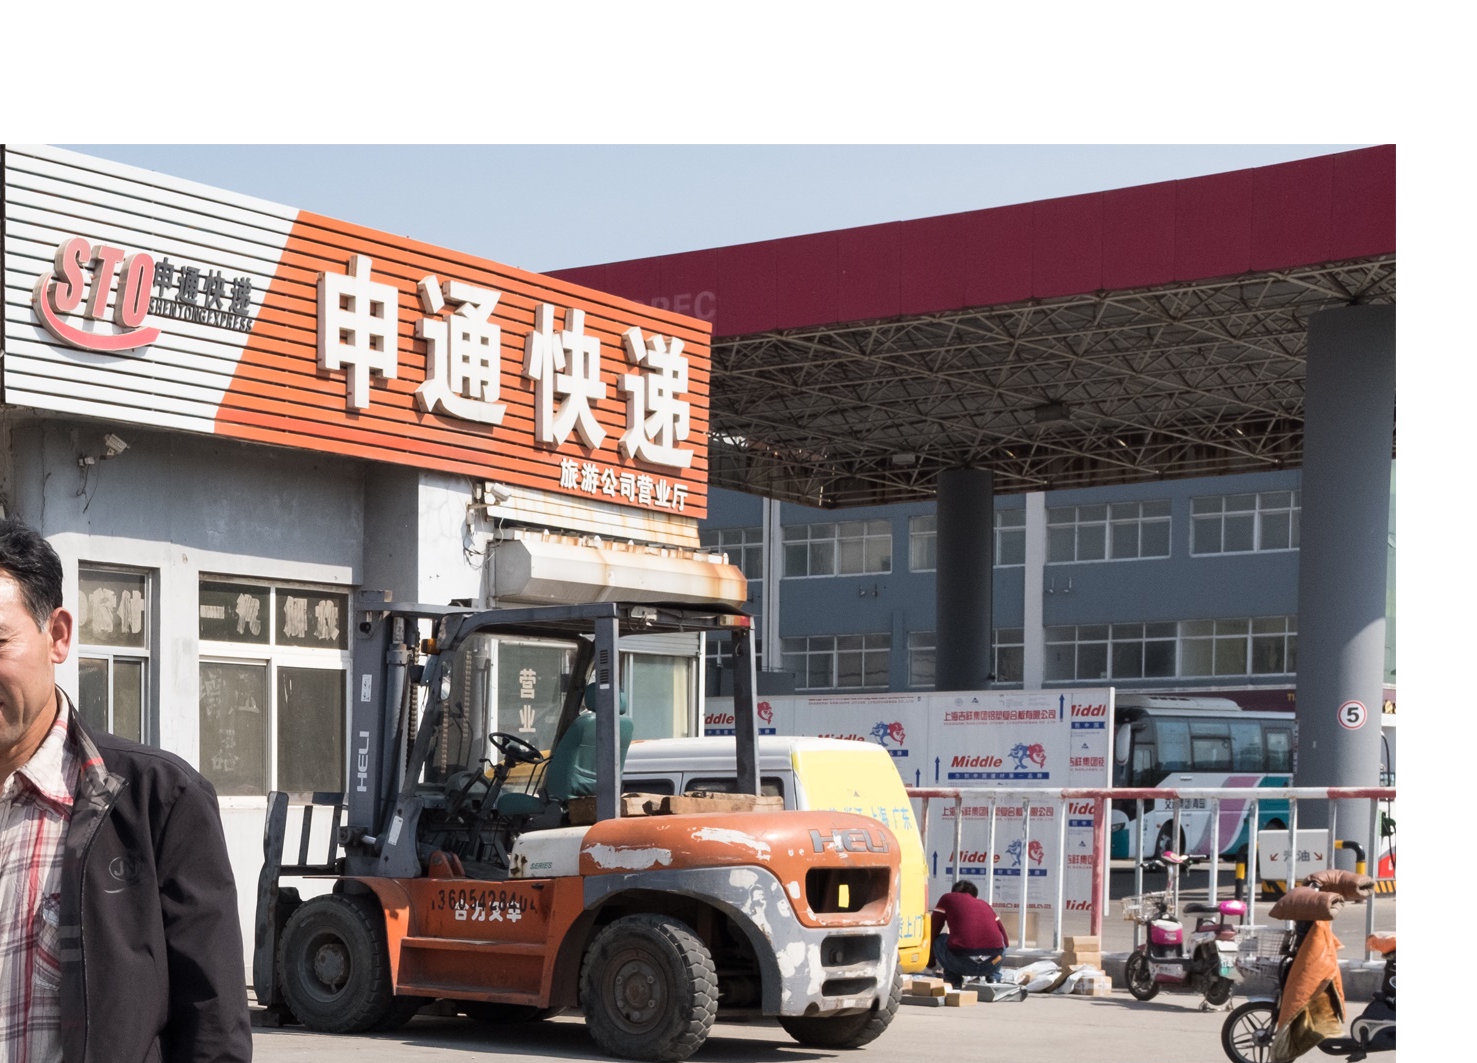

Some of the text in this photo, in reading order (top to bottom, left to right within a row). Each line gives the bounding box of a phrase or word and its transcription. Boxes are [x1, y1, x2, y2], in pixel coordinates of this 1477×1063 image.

[53, 236, 155, 328] STO
[153, 256, 253, 316] 申通快递
[316, 253, 697, 470] 申通快递
[559, 457, 689, 513] 旅游公司营业厅
[519, 668, 536, 733] 营业
[1346, 707, 1360, 723] 5
[356, 731, 369, 792] HELI
[951, 755, 1002, 768] Middle
[530, 861, 553, 870] SERIES
[808, 828, 890, 854] HELI
